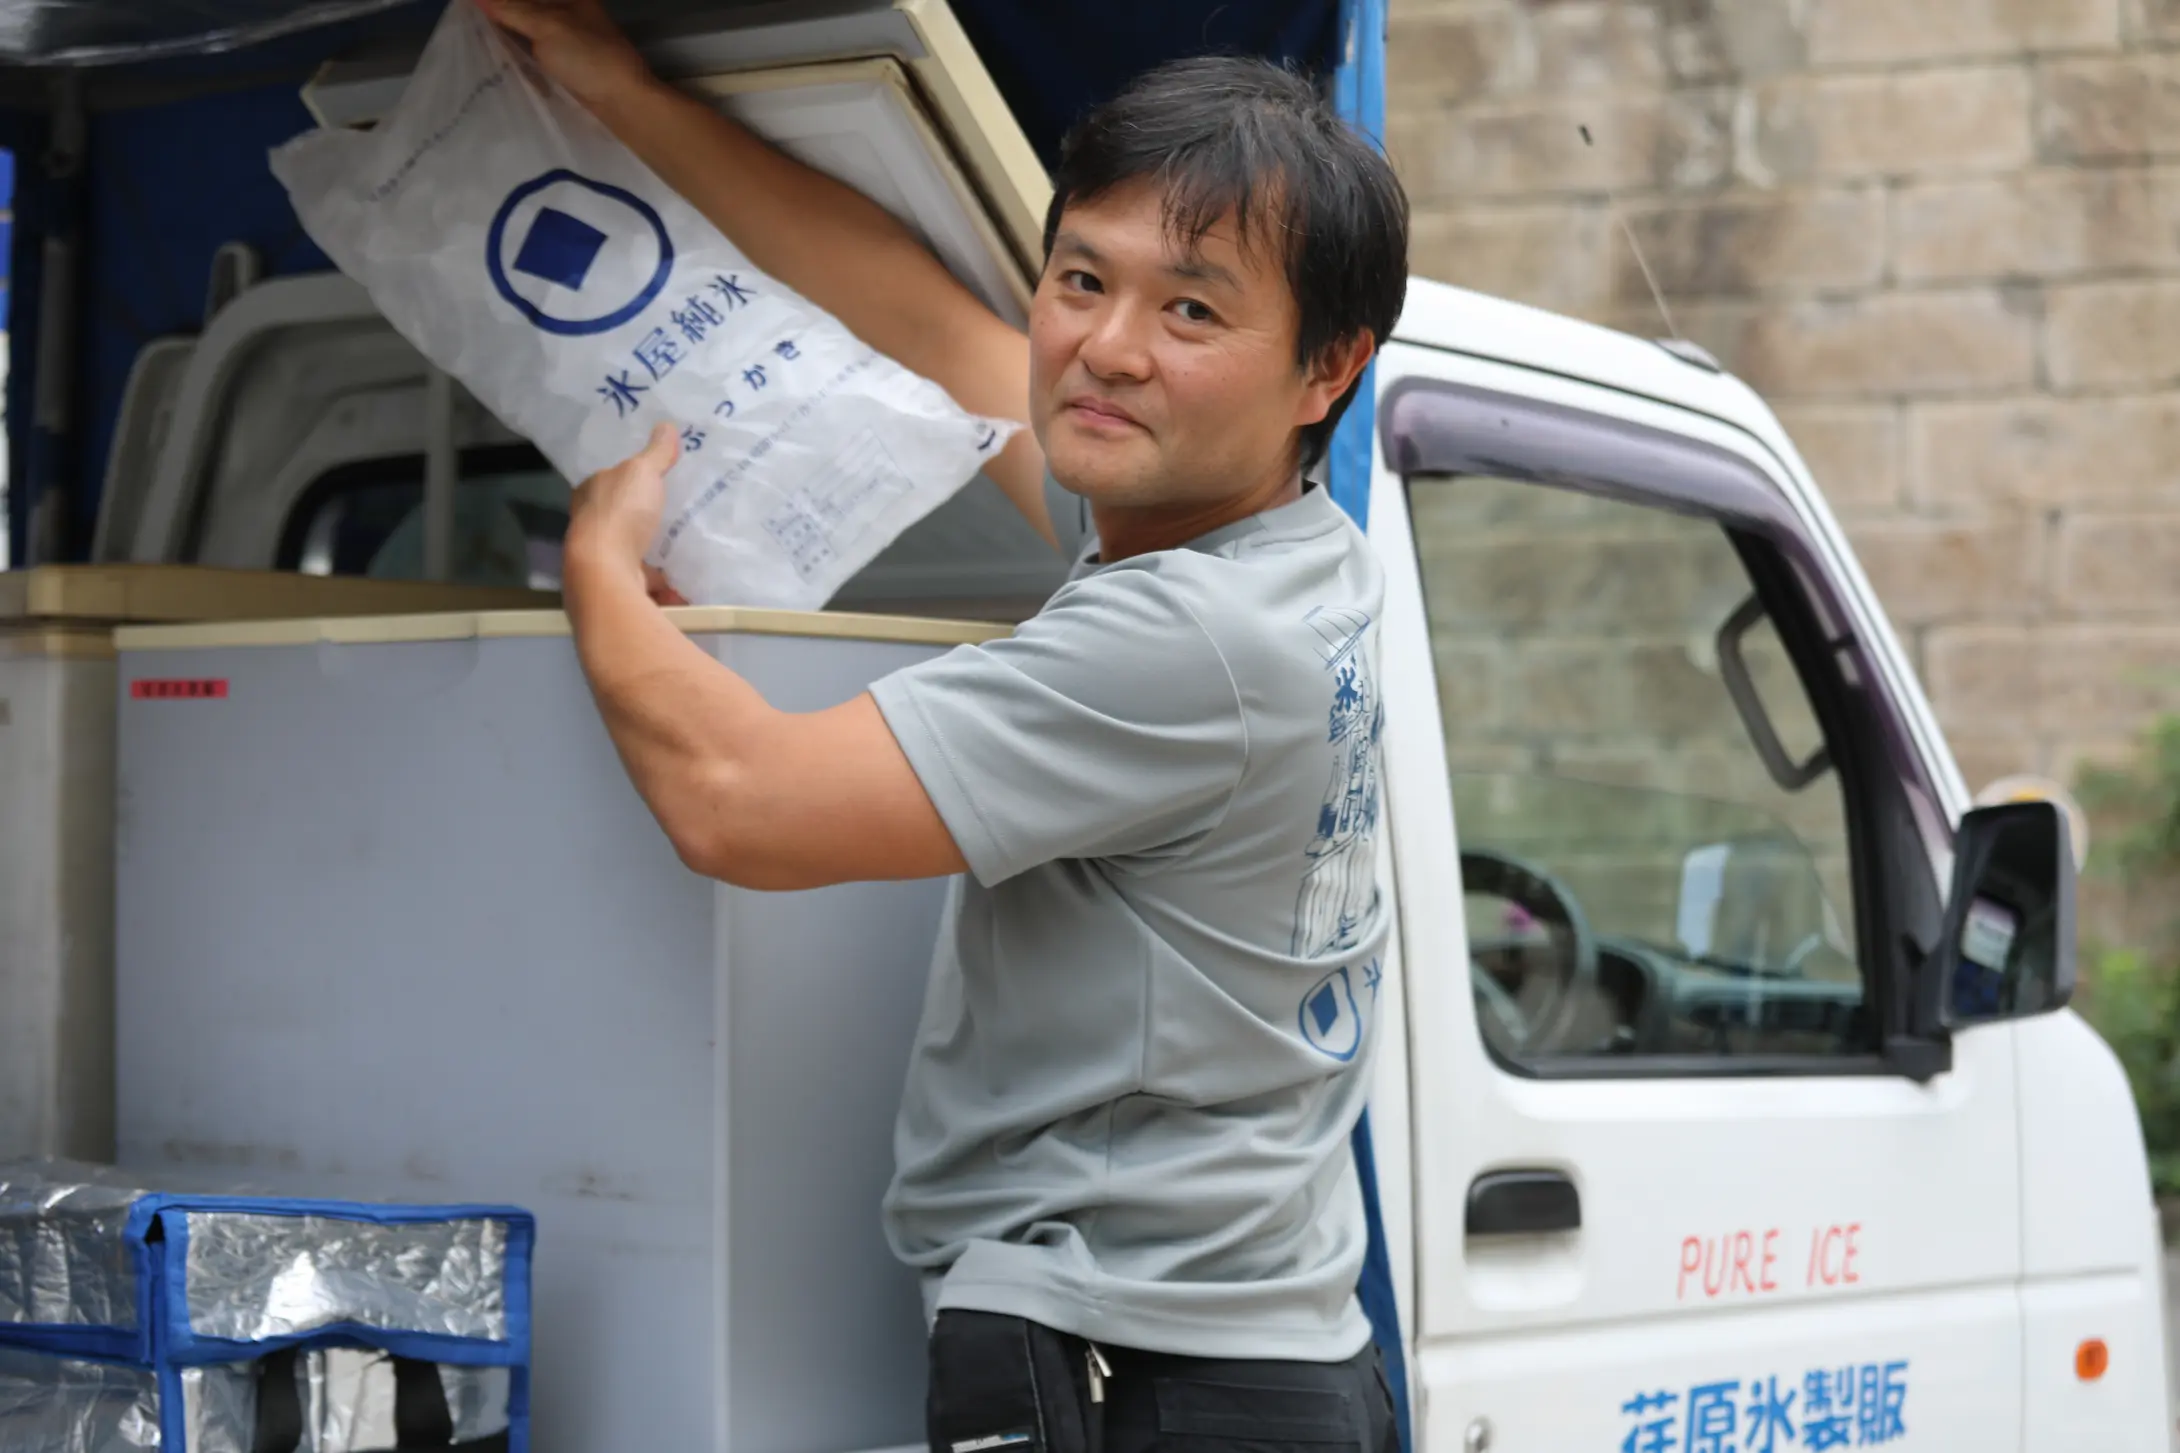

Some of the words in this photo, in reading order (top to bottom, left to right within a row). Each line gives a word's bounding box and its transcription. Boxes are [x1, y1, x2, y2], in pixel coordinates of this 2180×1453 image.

[595, 273, 758, 419] 氷屋純氷
[1676, 1228, 1780, 1300] PURE
[1806, 1222, 1863, 1287] ICE
[1620, 1357, 1910, 1453] 荏原氷製販
